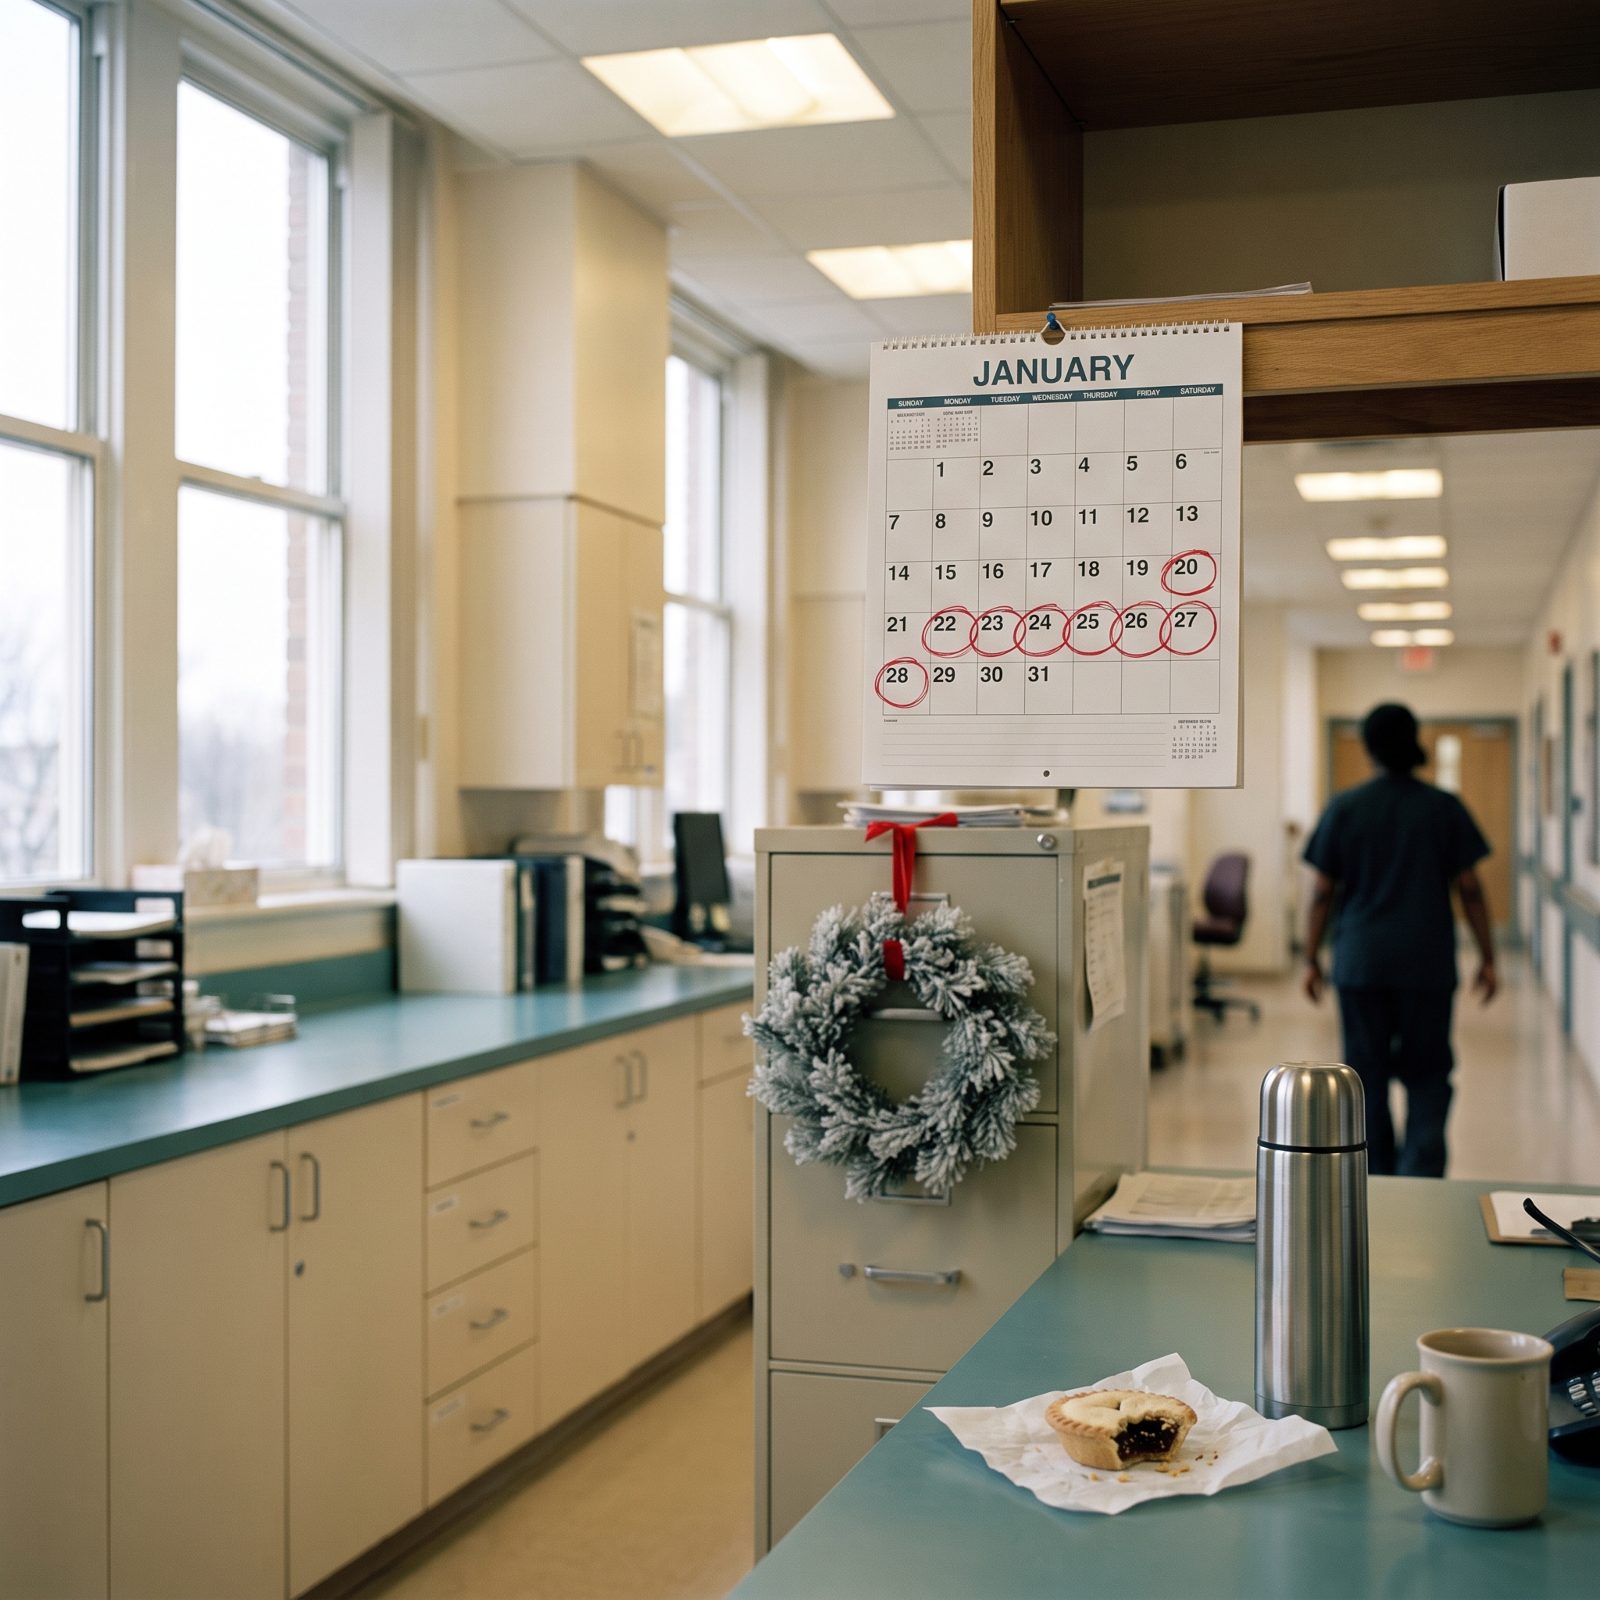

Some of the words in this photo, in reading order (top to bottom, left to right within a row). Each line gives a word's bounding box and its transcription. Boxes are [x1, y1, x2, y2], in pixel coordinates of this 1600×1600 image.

[973, 354, 1135, 387] JANUARY
[944, 397, 972, 405] MONDAY
[1031, 392, 1073, 401] WEDNESDAY
[1082, 391, 1119, 399] THURSDAY
[1136, 389, 1161, 397] FRIDAY
[1180, 386, 1216, 395] SATURDAY
[936, 461, 944, 478] 1
[982, 460, 994, 476] 2
[1030, 458, 1042, 475] 3
[1078, 457, 1090, 473] 4
[1126, 455, 1138, 472] 5
[1175, 453, 1187, 470] 6
[888, 514, 900, 530] 7
[935, 513, 946, 529] 8
[982, 511, 993, 528] 9
[1030, 510, 1053, 526] 10
[1078, 508, 1097, 525] 11
[1127, 507, 1149, 524] 12
[1176, 505, 1199, 522] 13
[888, 565, 910, 581] 14
[935, 564, 957, 580] 15
[982, 562, 1004, 579] 16
[1030, 562, 1052, 578] 17
[1078, 560, 1100, 577] 18
[1126, 559, 1149, 576] 19
[1174, 558, 1198, 575] 20
[887, 616, 907, 632] 21
[933, 615, 956, 632] 22
[981, 614, 1004, 631] 23
[1028, 614, 1052, 631] 24
[1076, 613, 1099, 630] 25
[1124, 612, 1148, 629] 26
[1174, 611, 1198, 628] 27
[886, 667, 909, 684] 28
[933, 666, 956, 683] 29
[980, 666, 1003, 683] 30
[1027, 665, 1048, 682] 31
